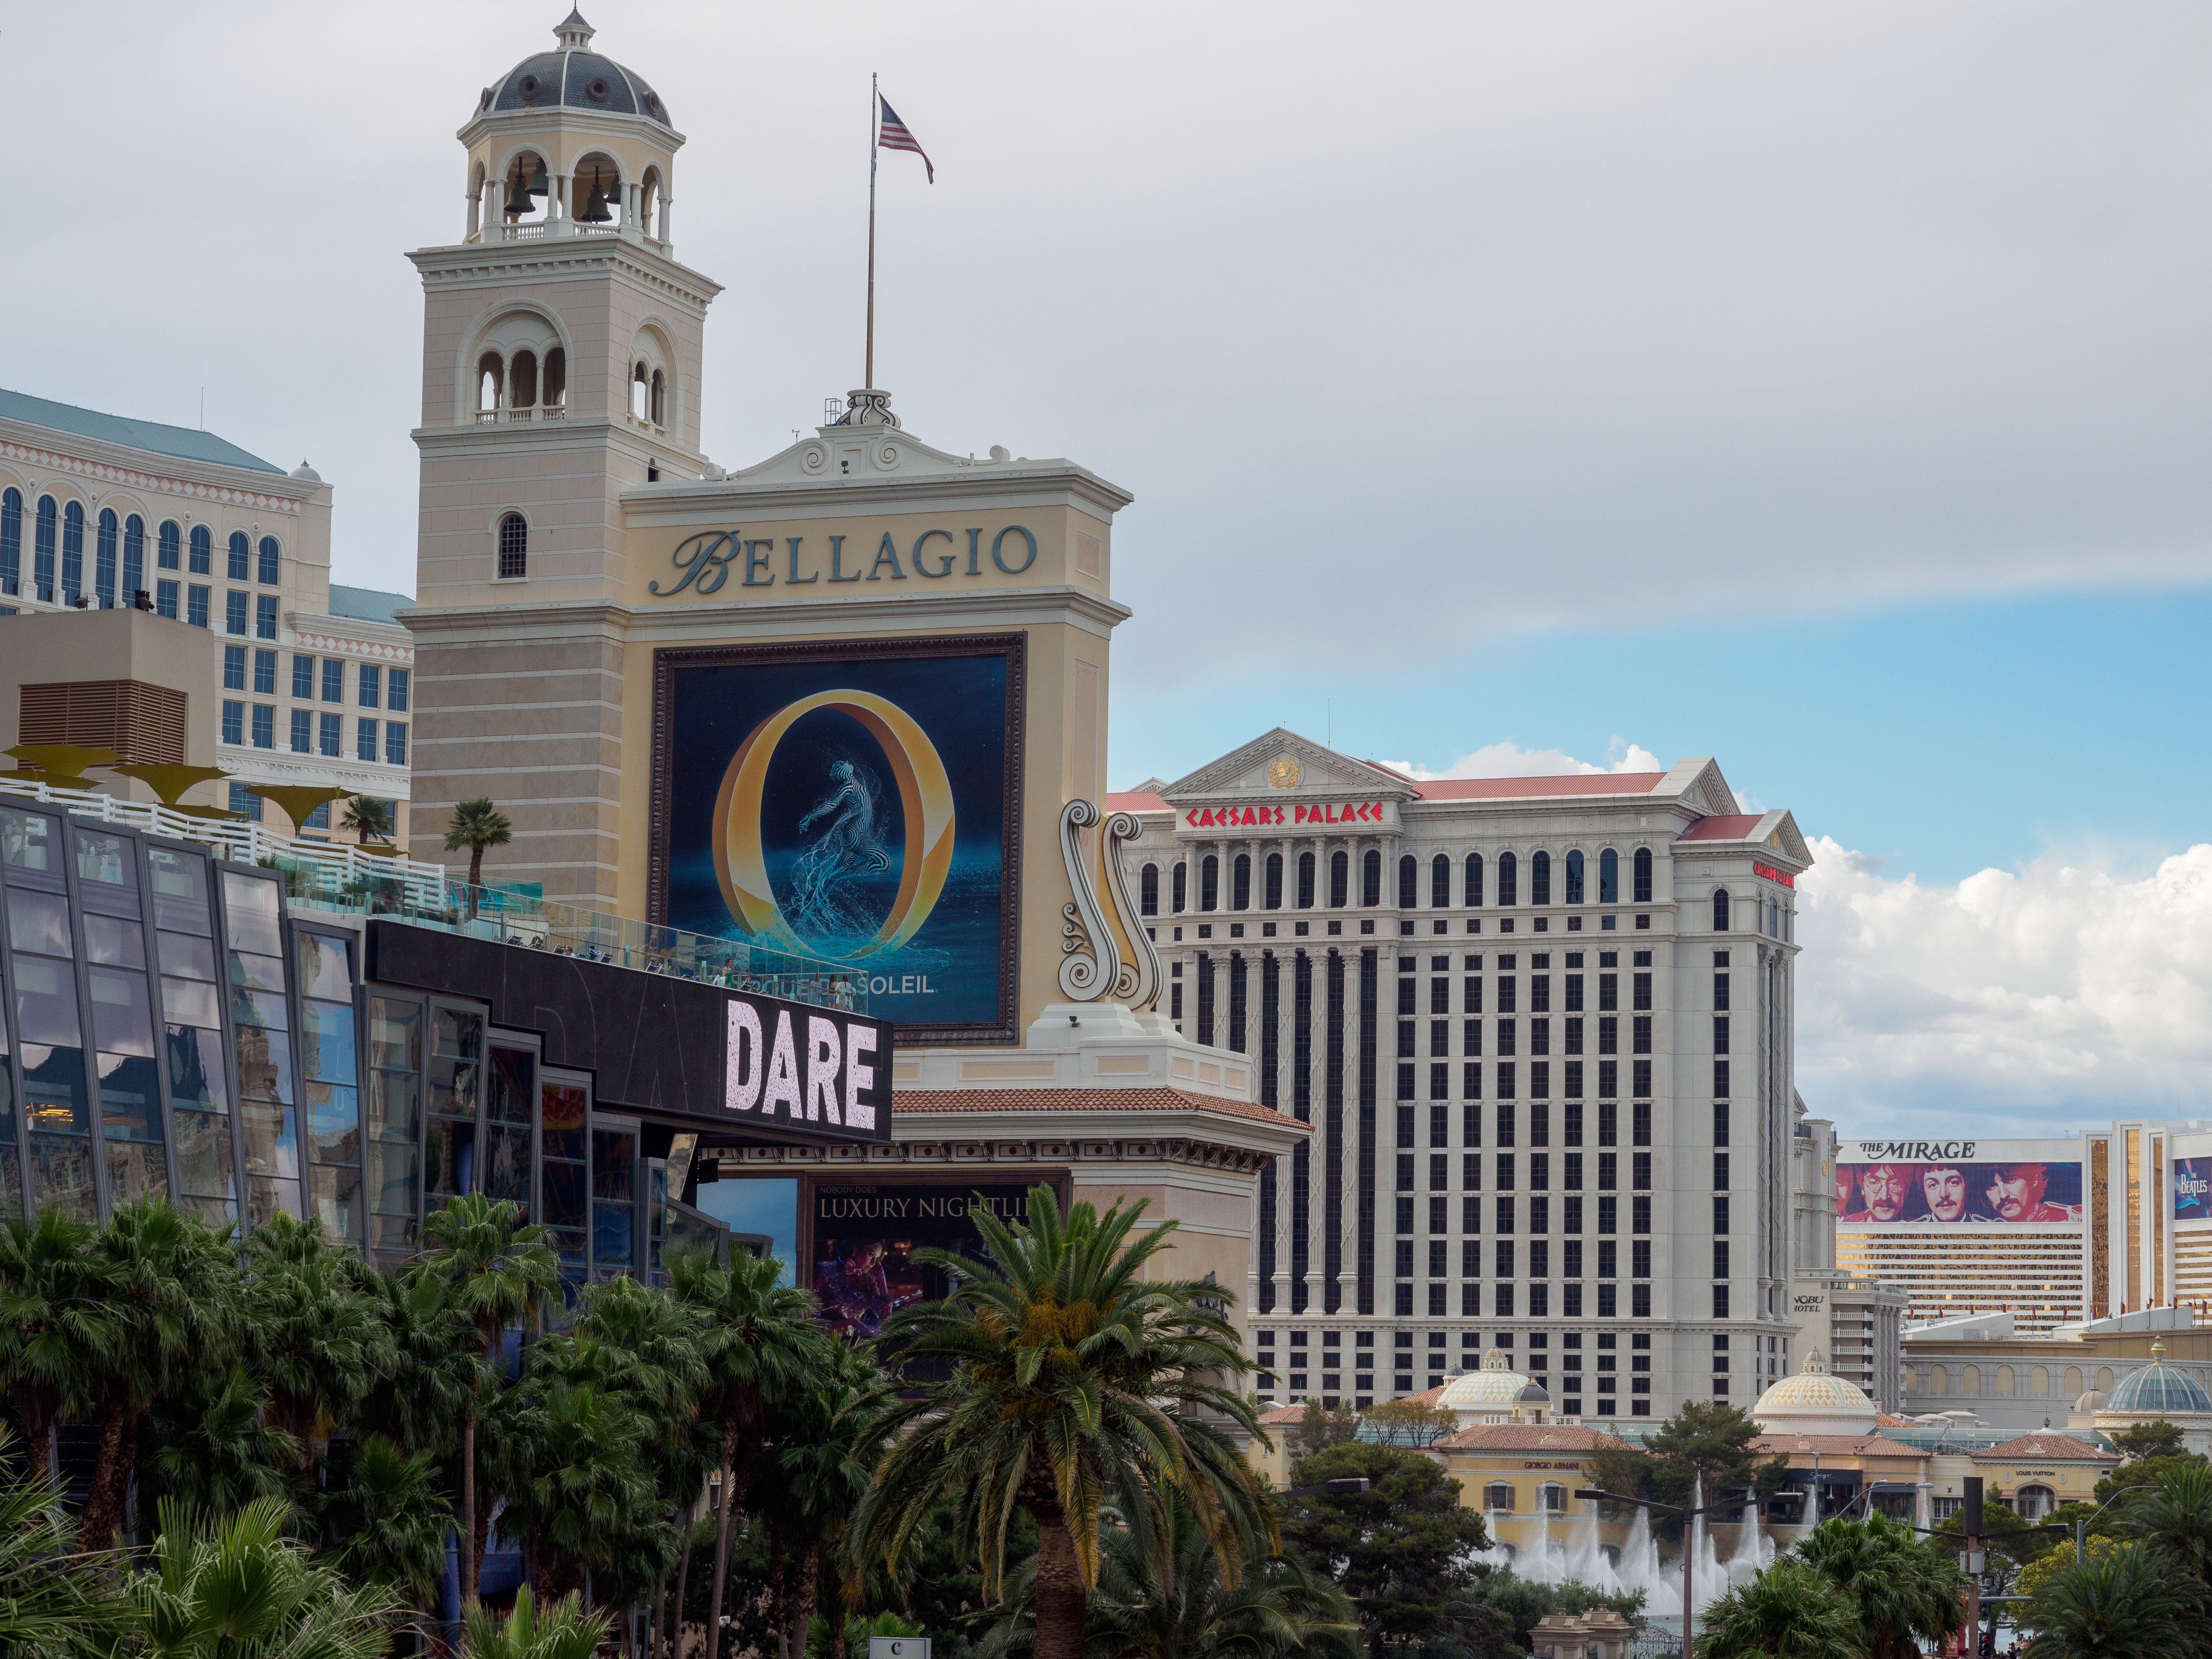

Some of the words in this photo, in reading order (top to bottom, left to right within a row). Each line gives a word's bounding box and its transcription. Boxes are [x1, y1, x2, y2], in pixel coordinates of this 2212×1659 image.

[649, 524, 1037, 596] BELLAGIO
[1186, 805, 1286, 828] CAESARS
[1295, 801, 1383, 824] PALACE
[857, 975, 935, 995] SOLEIL
[726, 999, 877, 1130] DARE
[1860, 1142, 1884, 1152] THE
[1868, 1142, 1975, 1161] MIRAGE
[2181, 1174, 2208, 1197] BEATLES
[820, 1198, 912, 1218] LUXURY
[918, 1197, 1032, 1218] NIGHTLI
